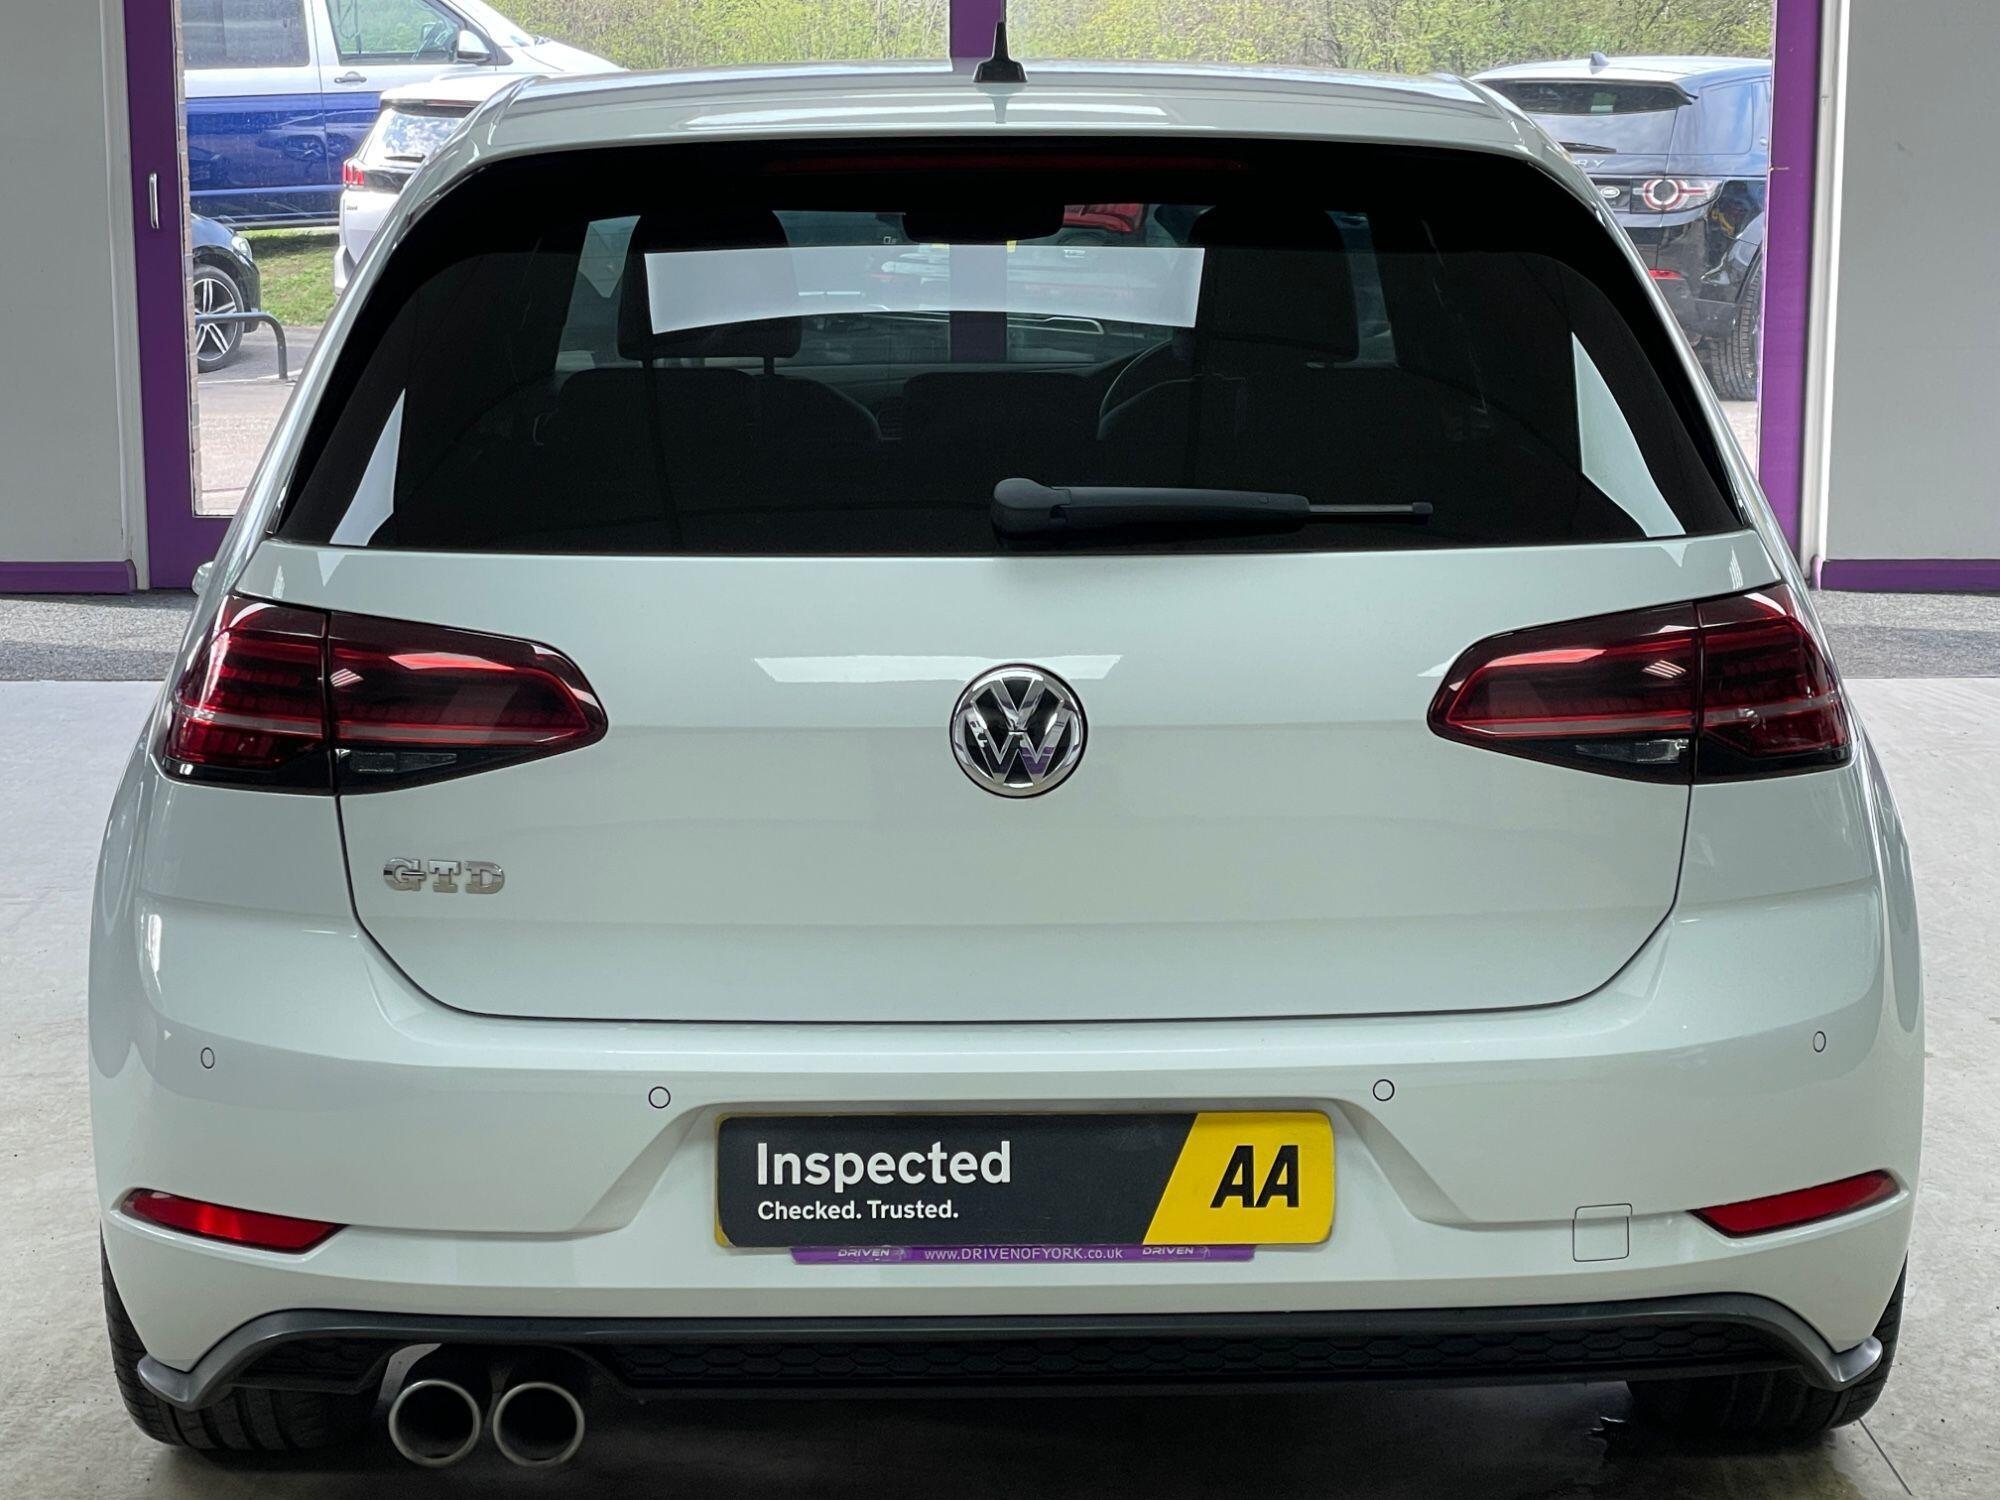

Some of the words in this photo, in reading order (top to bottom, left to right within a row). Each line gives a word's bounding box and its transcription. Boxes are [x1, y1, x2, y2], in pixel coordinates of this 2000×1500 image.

[383, 857, 506, 895] GTD
[757, 1140, 1011, 1193] Inspected
[1209, 1145, 1300, 1208] AA
[757, 1200, 862, 1220] Checked.
[867, 1199, 959, 1219] Trusted.
[837, 1248, 890, 1257] DRIVEN
[924, 1248, 1124, 1260] www.DRIVENOFYORK.co.uk
[1142, 1246, 1194, 1256] DRIVEN
